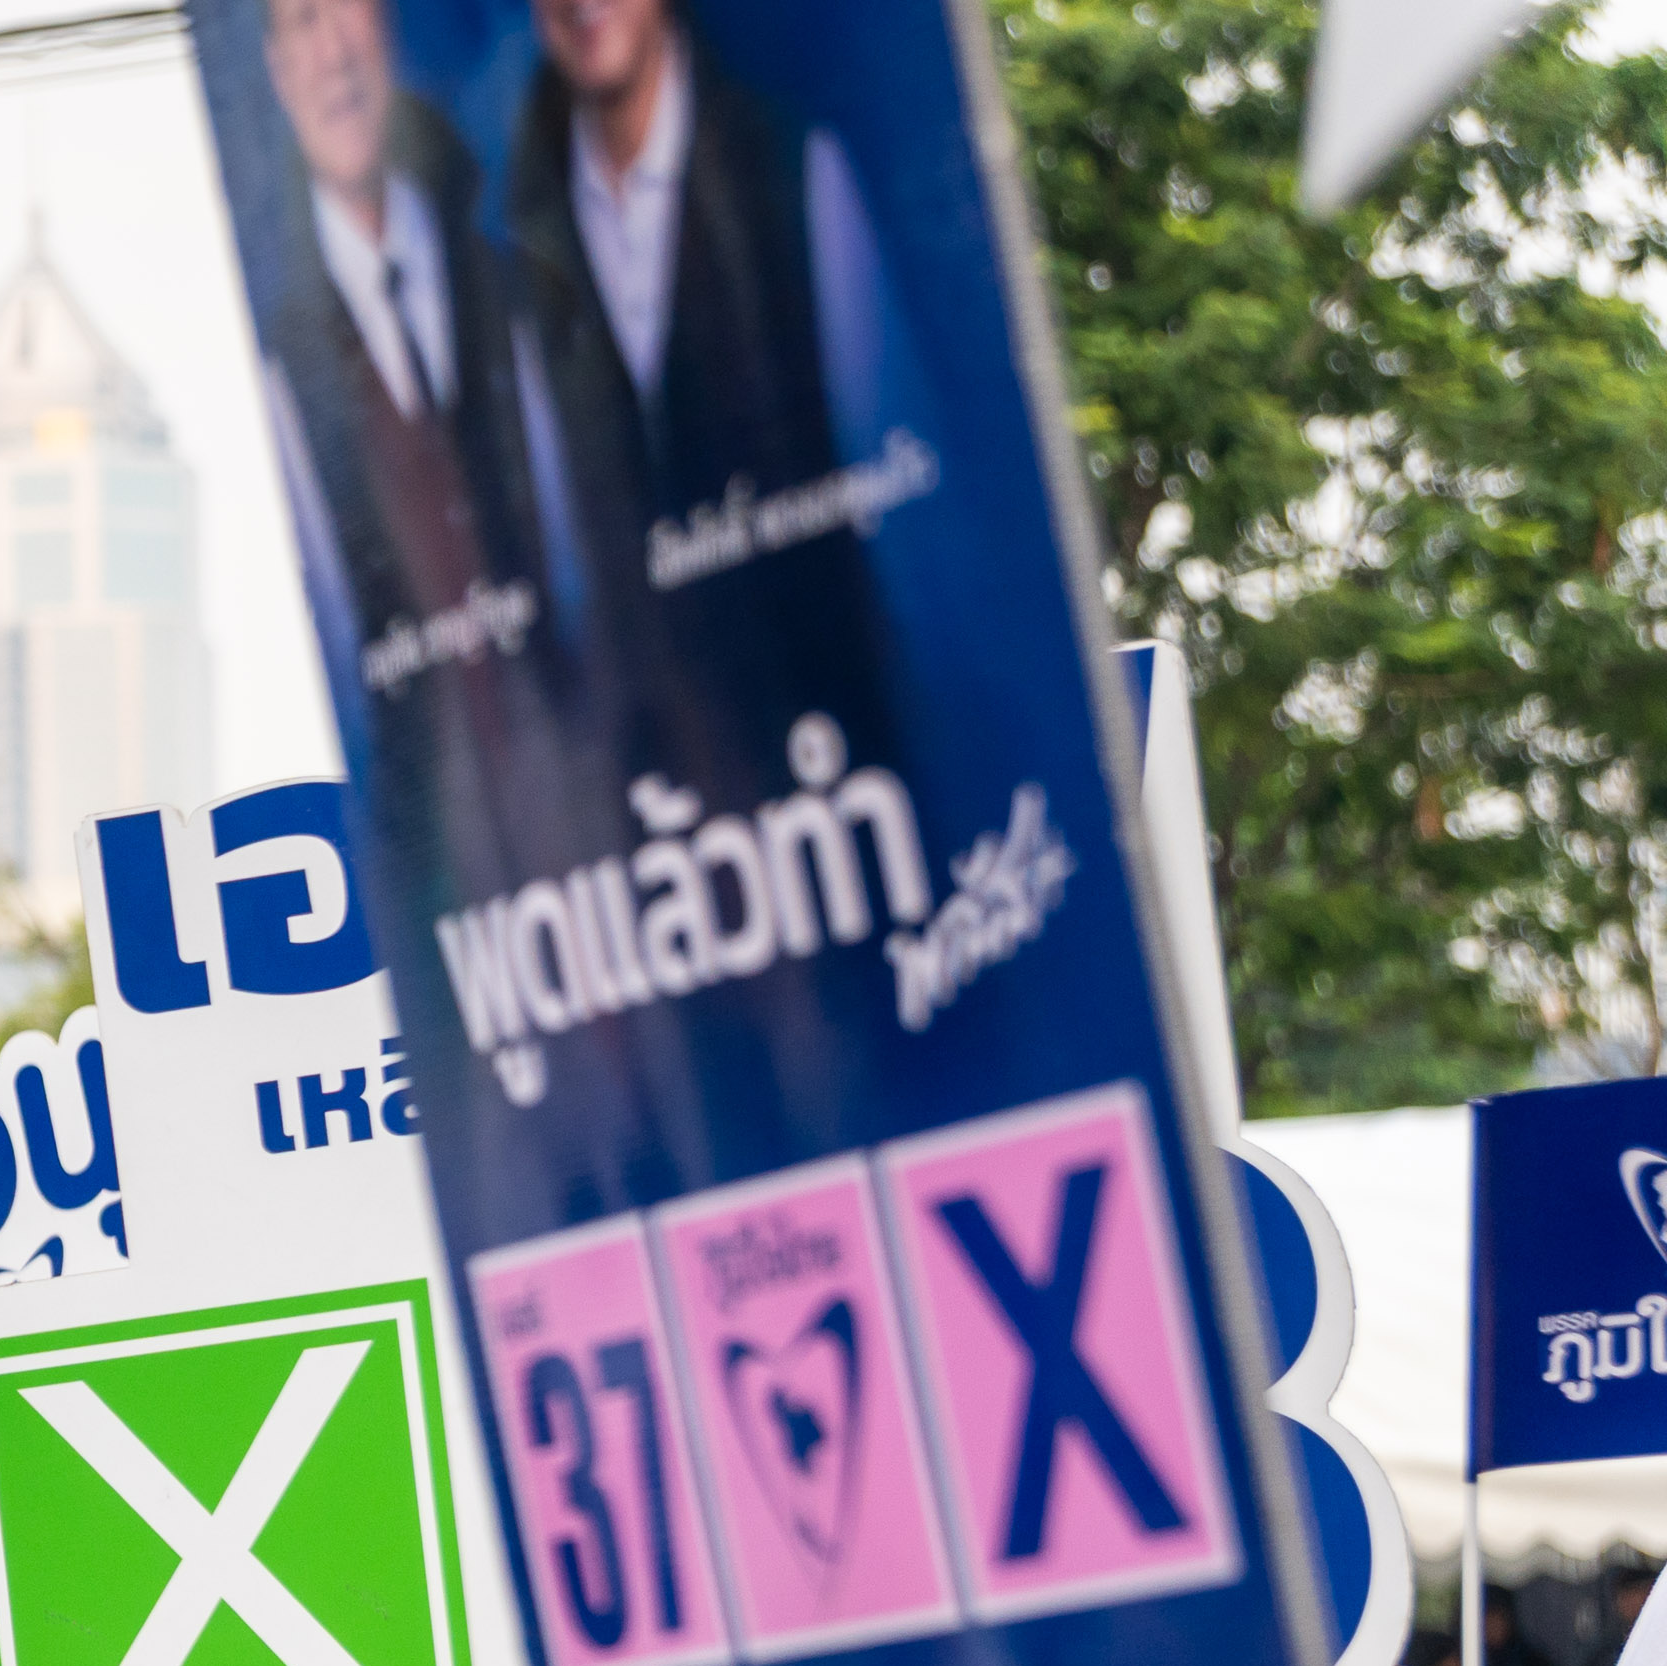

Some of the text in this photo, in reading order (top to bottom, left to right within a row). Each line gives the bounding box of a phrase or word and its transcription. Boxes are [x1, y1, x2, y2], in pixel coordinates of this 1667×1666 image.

[436, 710, 932, 1107] พูดแล้วทำ
[521, 1332, 685, 1653] 37
